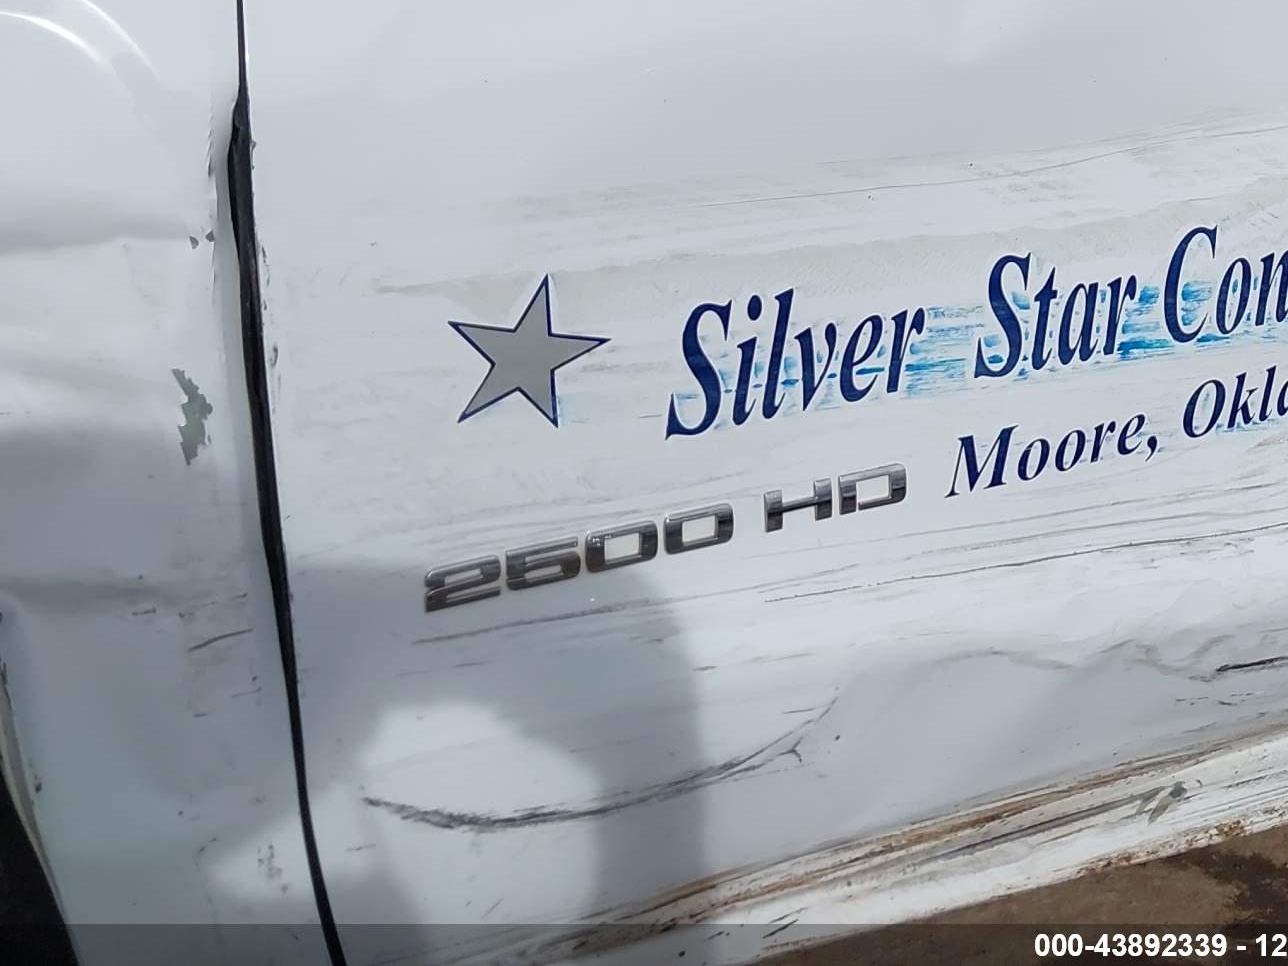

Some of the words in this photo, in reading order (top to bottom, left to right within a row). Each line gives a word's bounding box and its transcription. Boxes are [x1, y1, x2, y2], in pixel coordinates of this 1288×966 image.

[665, 288, 926, 440] Silver
[973, 252, 1137, 379] Star
[944, 413, 1158, 498] Moore,
[424, 502, 735, 613] 2500
[763, 462, 908, 533] HD
